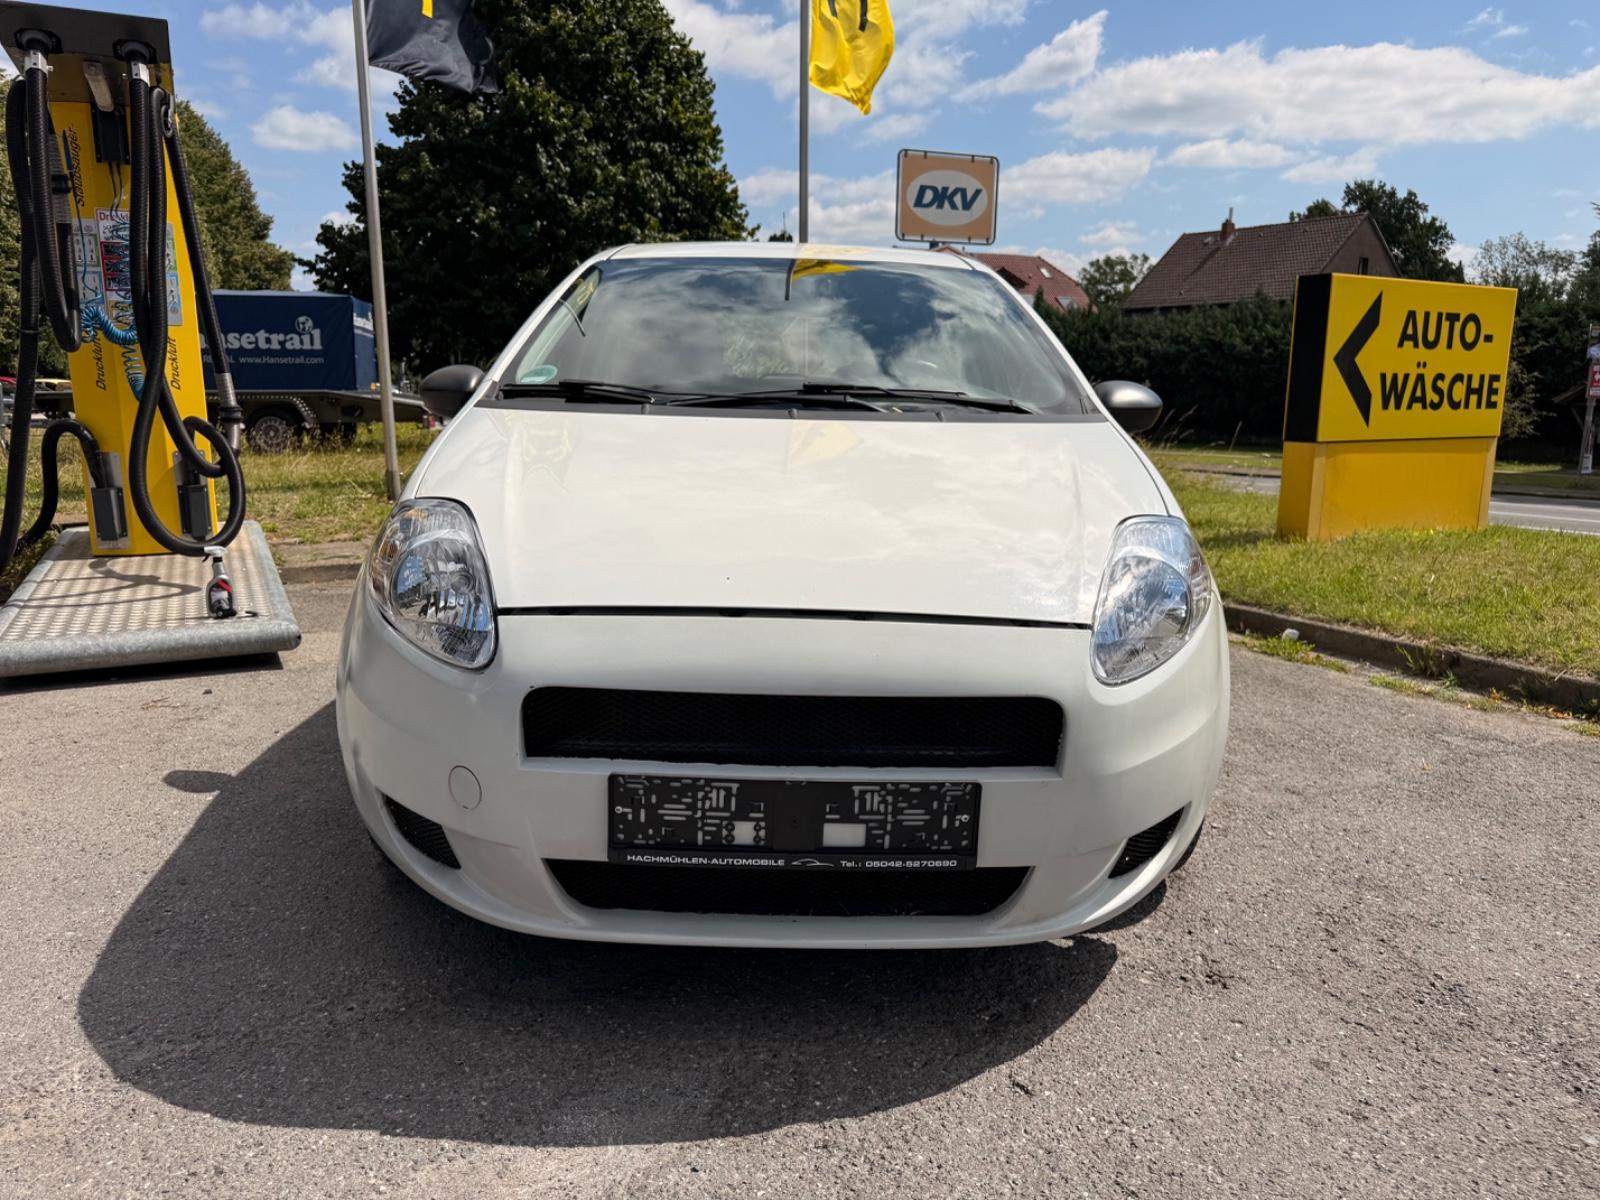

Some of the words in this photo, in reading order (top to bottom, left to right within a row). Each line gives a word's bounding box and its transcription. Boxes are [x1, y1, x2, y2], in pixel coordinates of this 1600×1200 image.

[913, 184, 983, 211] DKV
[1397, 310, 1494, 351] AUTO-
[168, 336, 181, 391] Druckluft
[239, 355, 324, 364] www.Hansetrail.com
[1379, 361, 1501, 411] WÄSCHE
[627, 854, 785, 867] HACHMÜHLEN-AUTOMOBILE
